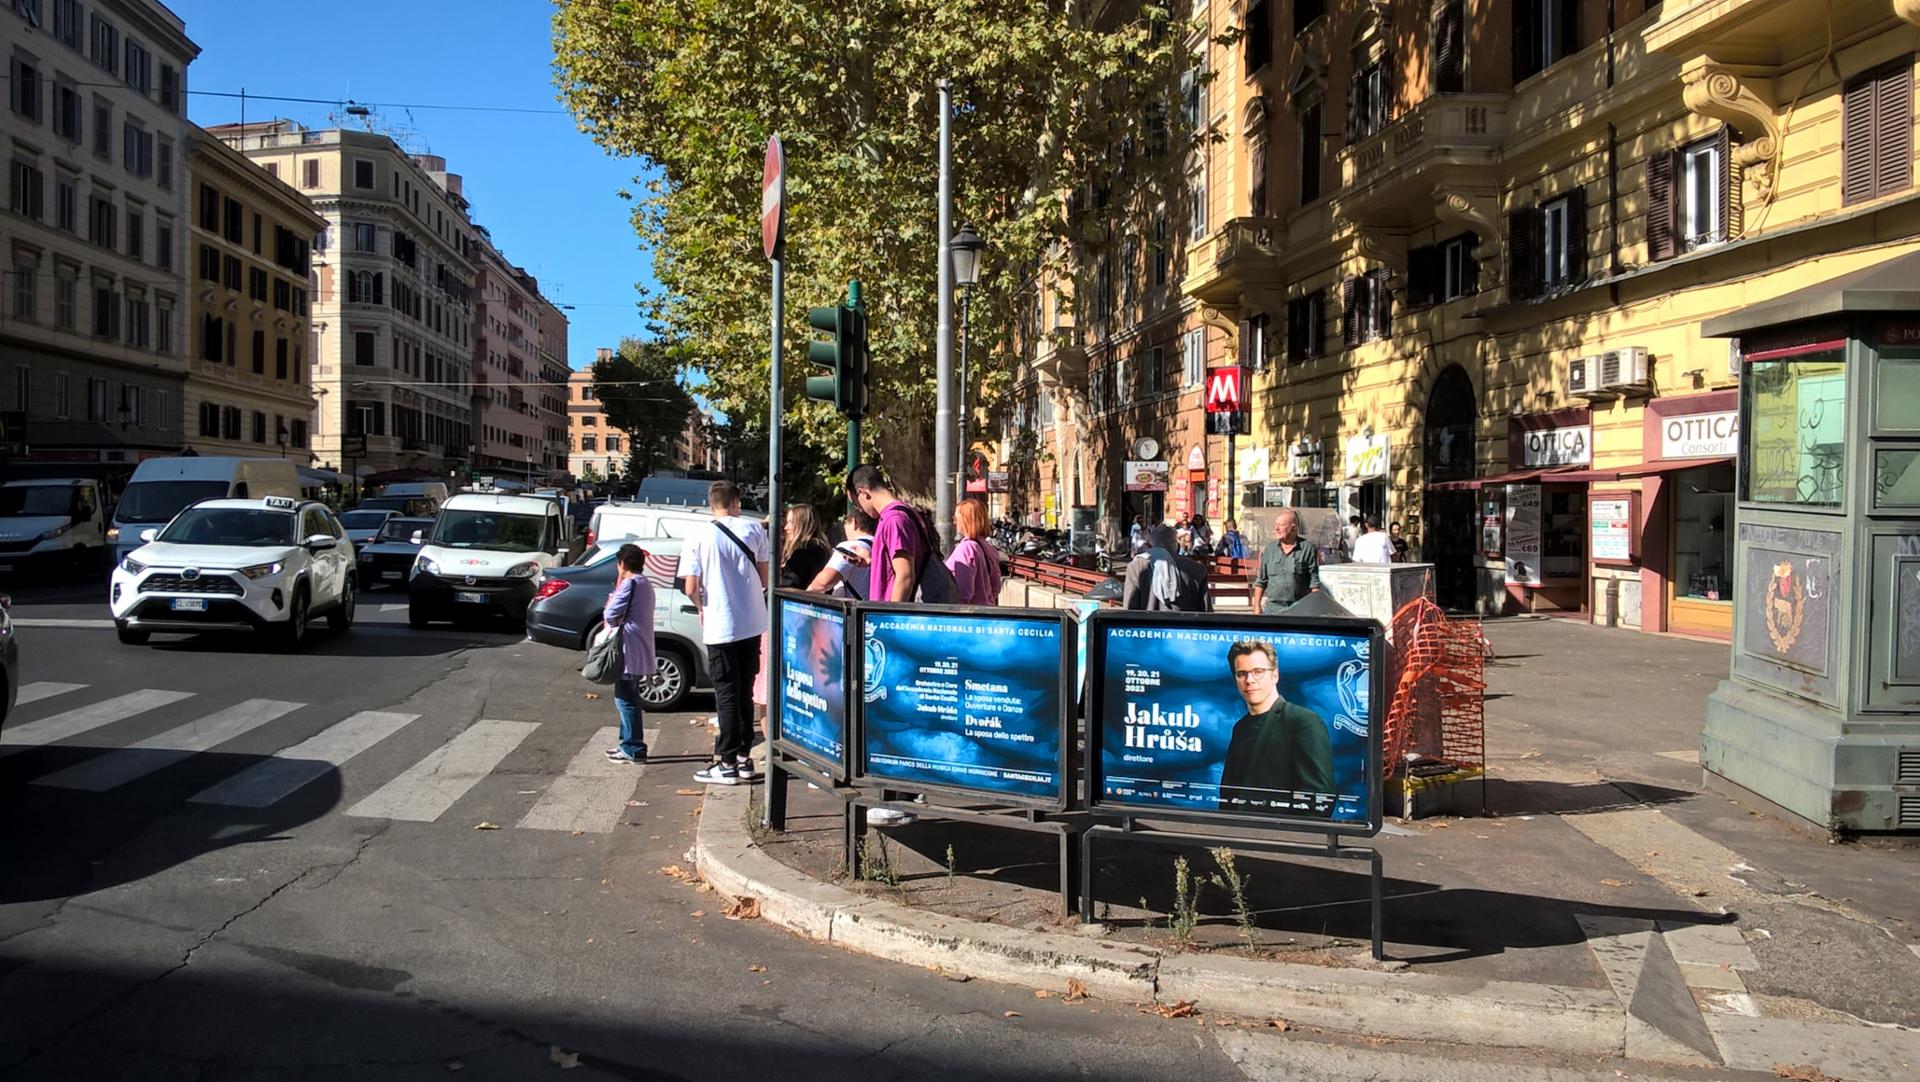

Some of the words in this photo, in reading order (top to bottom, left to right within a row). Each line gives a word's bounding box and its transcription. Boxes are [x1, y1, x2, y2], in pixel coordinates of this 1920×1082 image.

[1209, 374, 1237, 404] M
[1667, 415, 1739, 442] OTTICA
[1530, 430, 1585, 452] OTTICA
[1681, 441, 1727, 455] Consorti
[271, 499, 291, 507] TAXI
[879, 622, 925, 631] ACCADEMIA
[927, 624, 974, 634] NAZIONALE
[975, 626, 985, 634] DI
[987, 627, 1015, 636] SANTA
[1017, 628, 1055, 638] CECILIA
[1110, 629, 1173, 639] ACCADEMIA
[1177, 632, 1239, 642] NAZIONALE
[1243, 635, 1255, 643] DI
[1259, 636, 1296, 645] SANTA
[1300, 639, 1347, 648] CECILIA
[964, 679, 1009, 693] Smetana
[1125, 677, 1160, 686] OTTOBRE
[1125, 685, 1146, 693] 2023
[965, 693, 974, 701] La
[974, 695, 993, 703] sposa
[964, 702, 996, 711] Ouverture
[1002, 704, 1024, 714] Danze
[1123, 702, 1201, 728] Jakub
[965, 714, 1002, 728] Dvořák
[965, 728, 974, 736] La
[974, 730, 993, 738] sposa
[993, 730, 1010, 740] dello
[1010, 733, 1035, 742] spettro
[1124, 725, 1203, 752] Hrůša
[870, 757, 899, 766] AUDITORIUM
[899, 759, 916, 768] PARCO
[916, 761, 932, 769] DELLA
[932, 763, 952, 771] MUSICA
[1122, 754, 1154, 763] direttore
